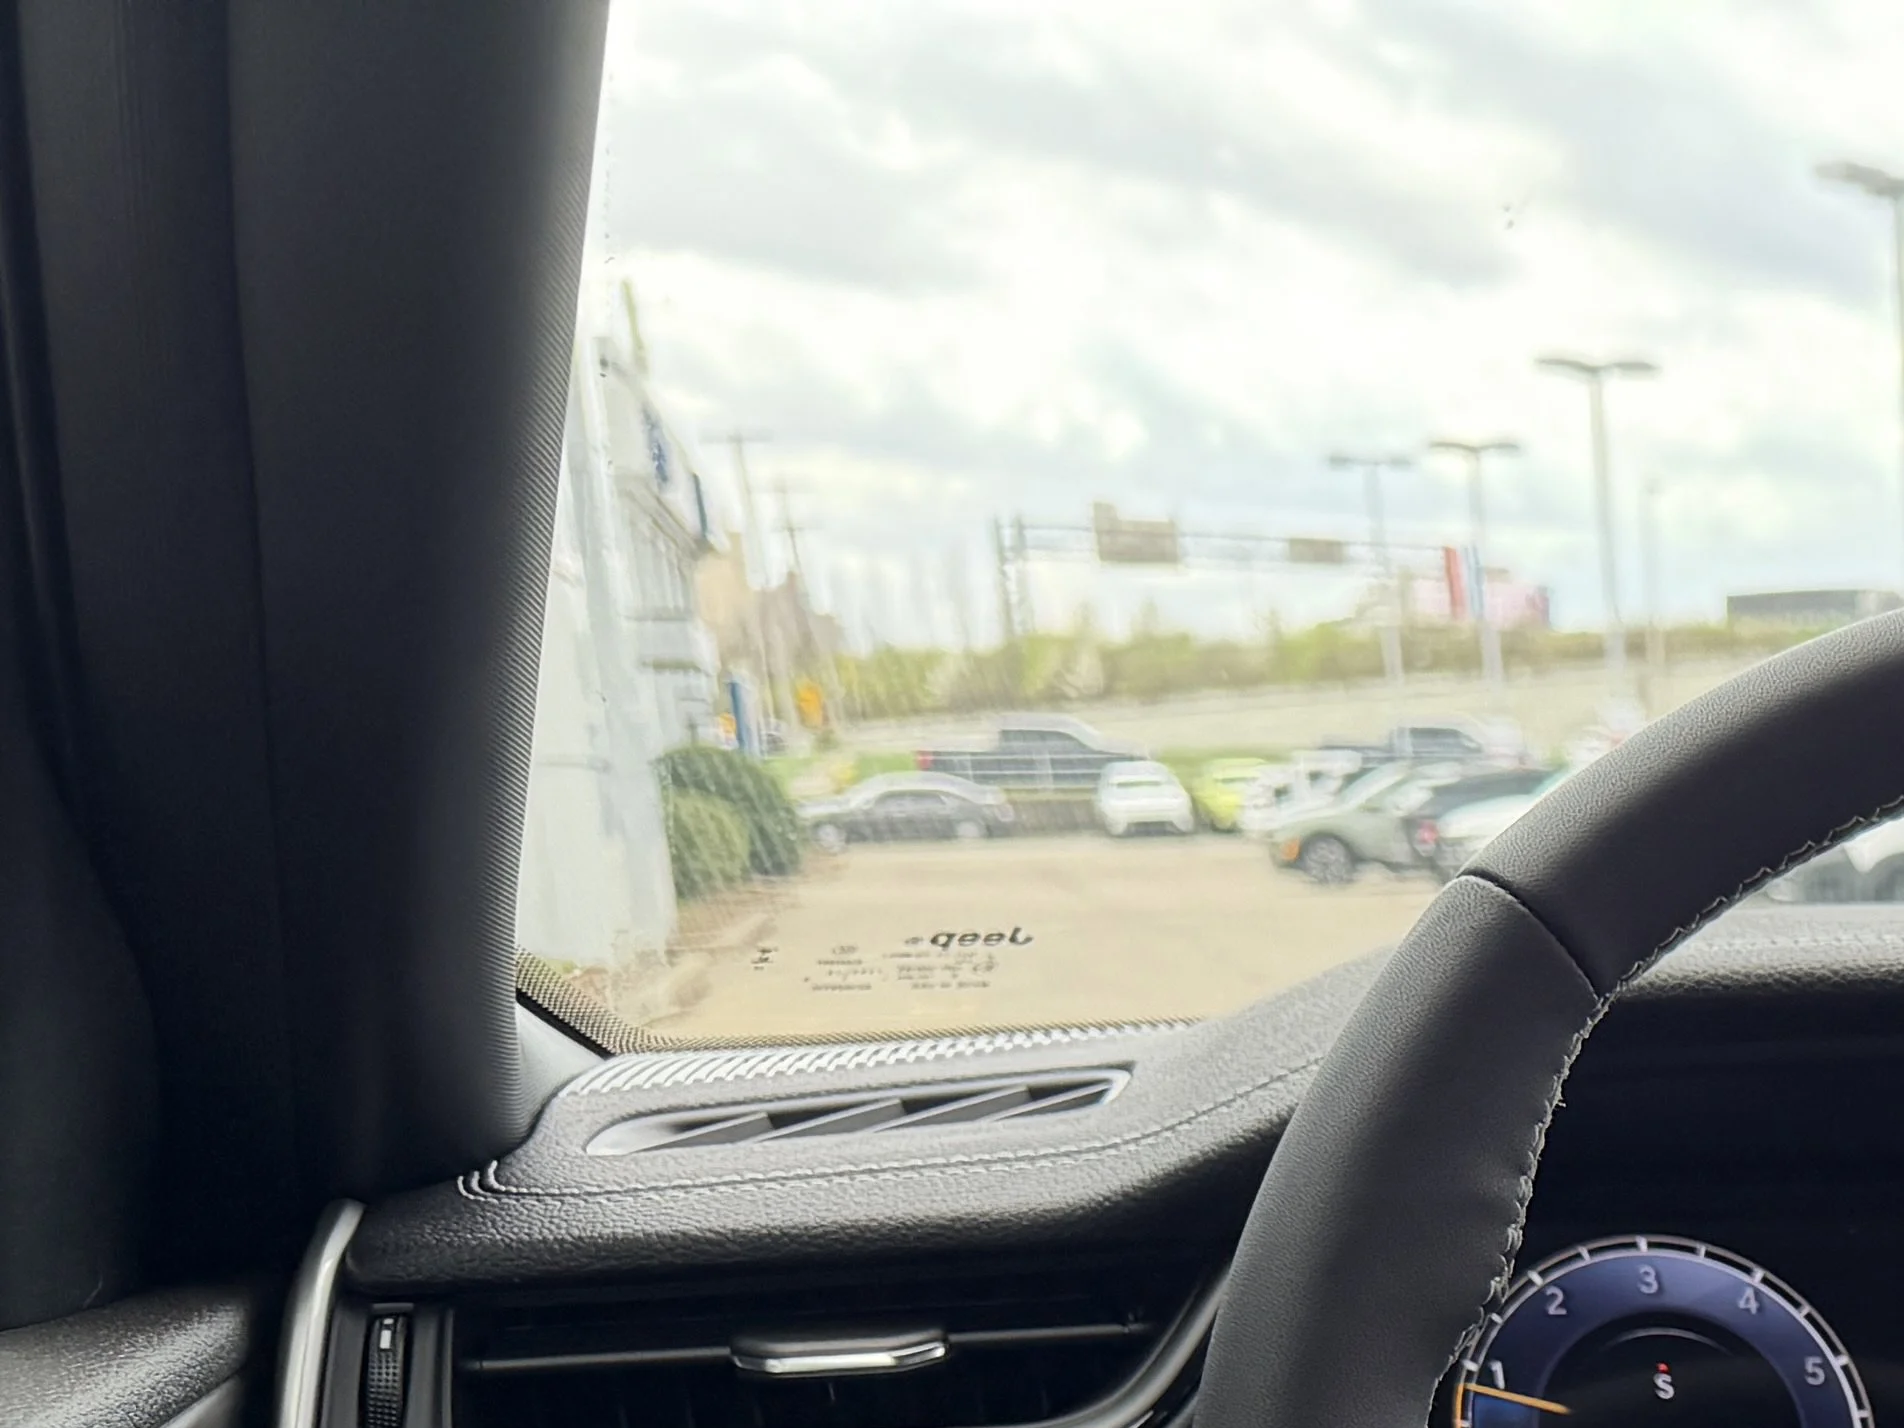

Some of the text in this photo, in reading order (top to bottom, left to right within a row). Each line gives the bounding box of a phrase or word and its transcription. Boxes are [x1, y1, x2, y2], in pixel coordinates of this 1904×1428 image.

[1637, 1264, 1658, 1294] 3
[1545, 1287, 1567, 1316] 2
[1737, 1288, 1760, 1315] 4
[1489, 1361, 1506, 1390] 1
[1804, 1356, 1826, 1386] 5
[1653, 1372, 1675, 1400] S
